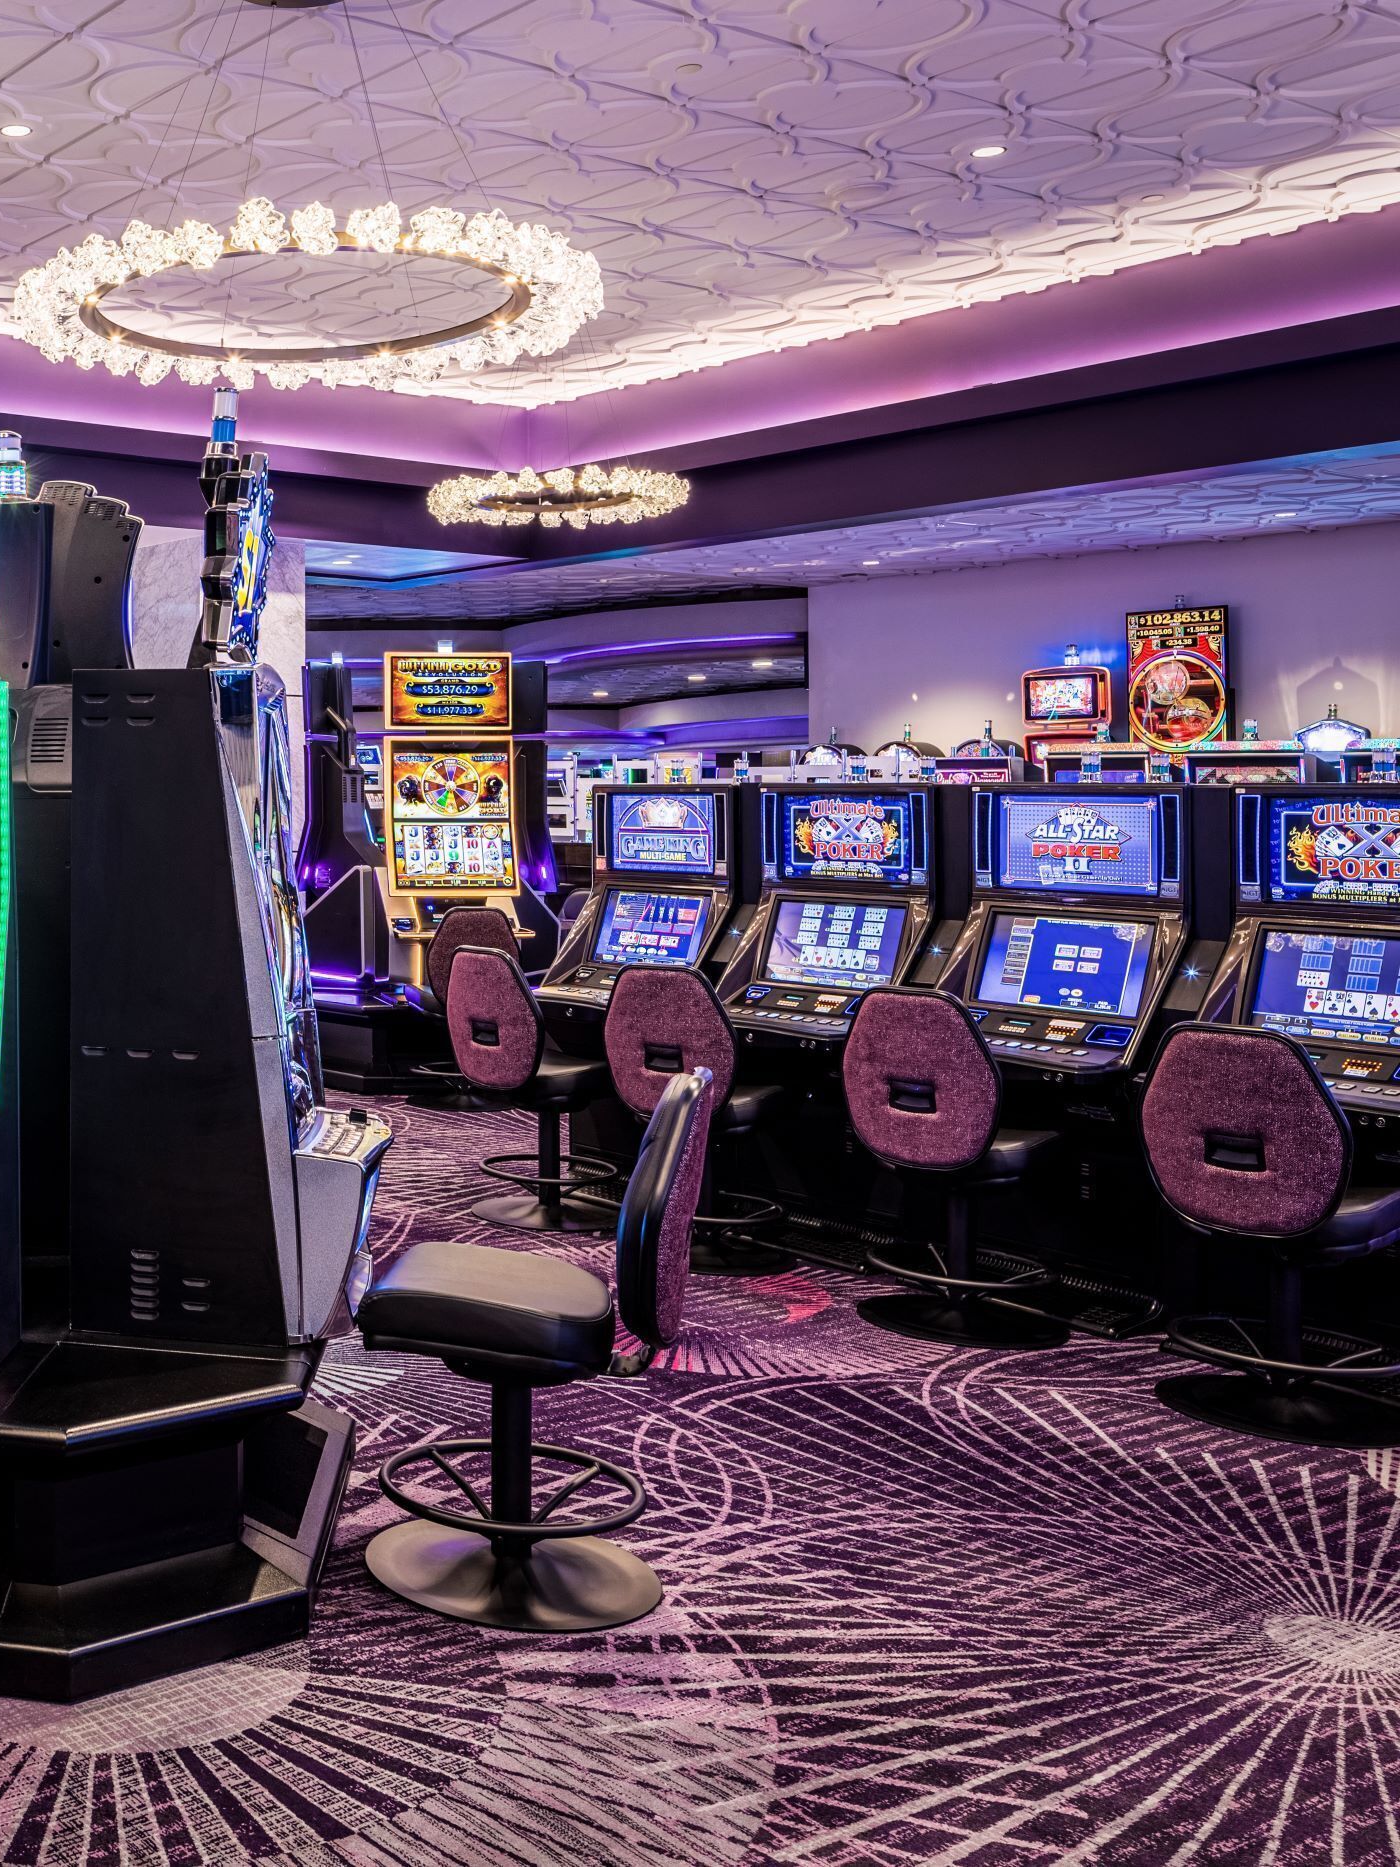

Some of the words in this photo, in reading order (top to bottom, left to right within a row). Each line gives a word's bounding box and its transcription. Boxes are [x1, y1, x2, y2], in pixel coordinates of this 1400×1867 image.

[450, 661, 501, 672] GOLD
[422, 685, 478, 694] $53,876.29
[427, 706, 473, 714] $11,977.33
[810, 798, 886, 819] Ultimate
[1034, 817, 1119, 843] ALL-STAR
[466, 840, 478, 849] 10
[621, 836, 665, 858] GAME
[665, 837, 706, 861] KING
[814, 842, 883, 861] POKER
[1032, 843, 1121, 861] POKER
[640, 852, 687, 861] MULTI-GAME
[468, 863, 480, 872] 10
[1330, 888, 1365, 896] WINNING
[1338, 894, 1388, 902] MULTIPLIERS
